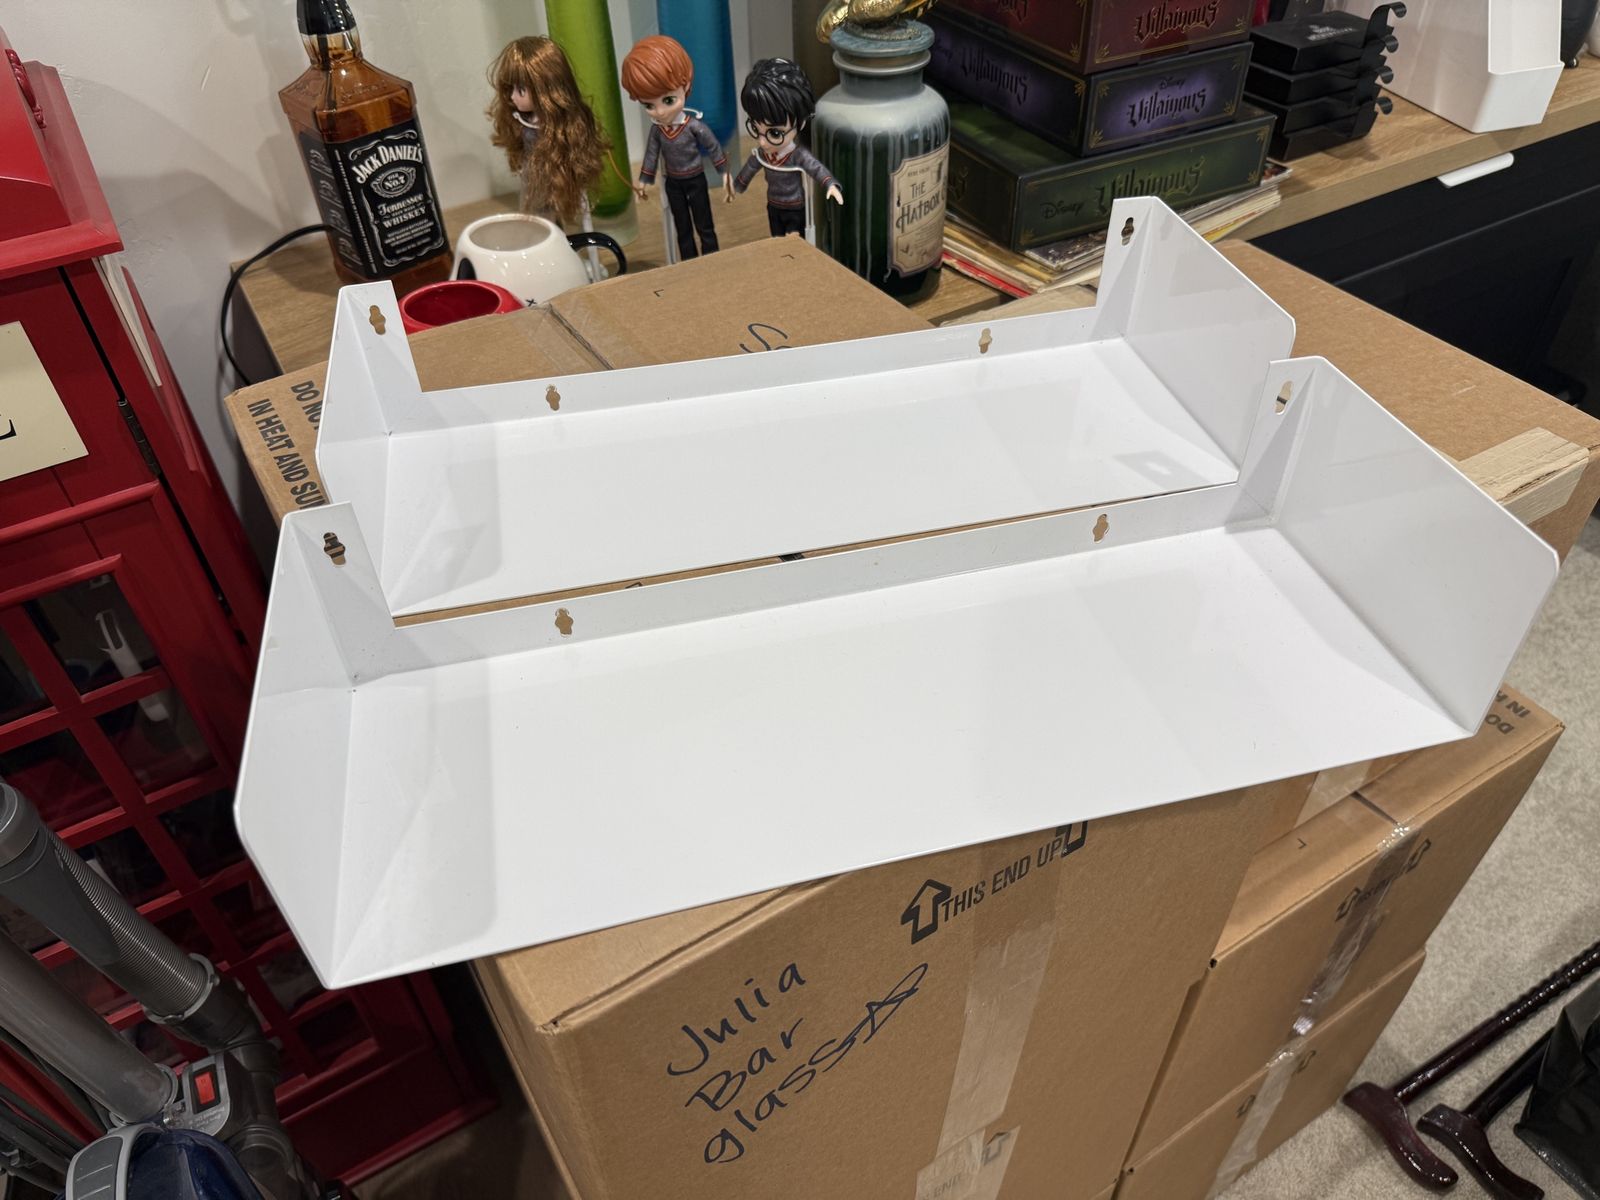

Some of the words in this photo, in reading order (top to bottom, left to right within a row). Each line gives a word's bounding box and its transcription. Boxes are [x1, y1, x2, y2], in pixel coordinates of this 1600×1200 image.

[1126, 87, 1207, 127] Villainous
[351, 153, 383, 184] JACK
[377, 143, 424, 165] DANIEL'S
[377, 193, 424, 216] Tennessee
[911, 181, 926, 199] THE
[382, 206, 427, 229] WHISKEY
[291, 380, 320, 402] DO
[247, 398, 276, 418] IN
[301, 400, 323, 431] NO
[255, 414, 295, 452] HEAT
[273, 452, 310, 483] AND
[941, 880, 987, 923] THIS
[991, 855, 1031, 895] END
[1036, 837, 1065, 868] UP
[666, 962, 807, 1077] Julia
[684, 1017, 804, 1112] Bar
